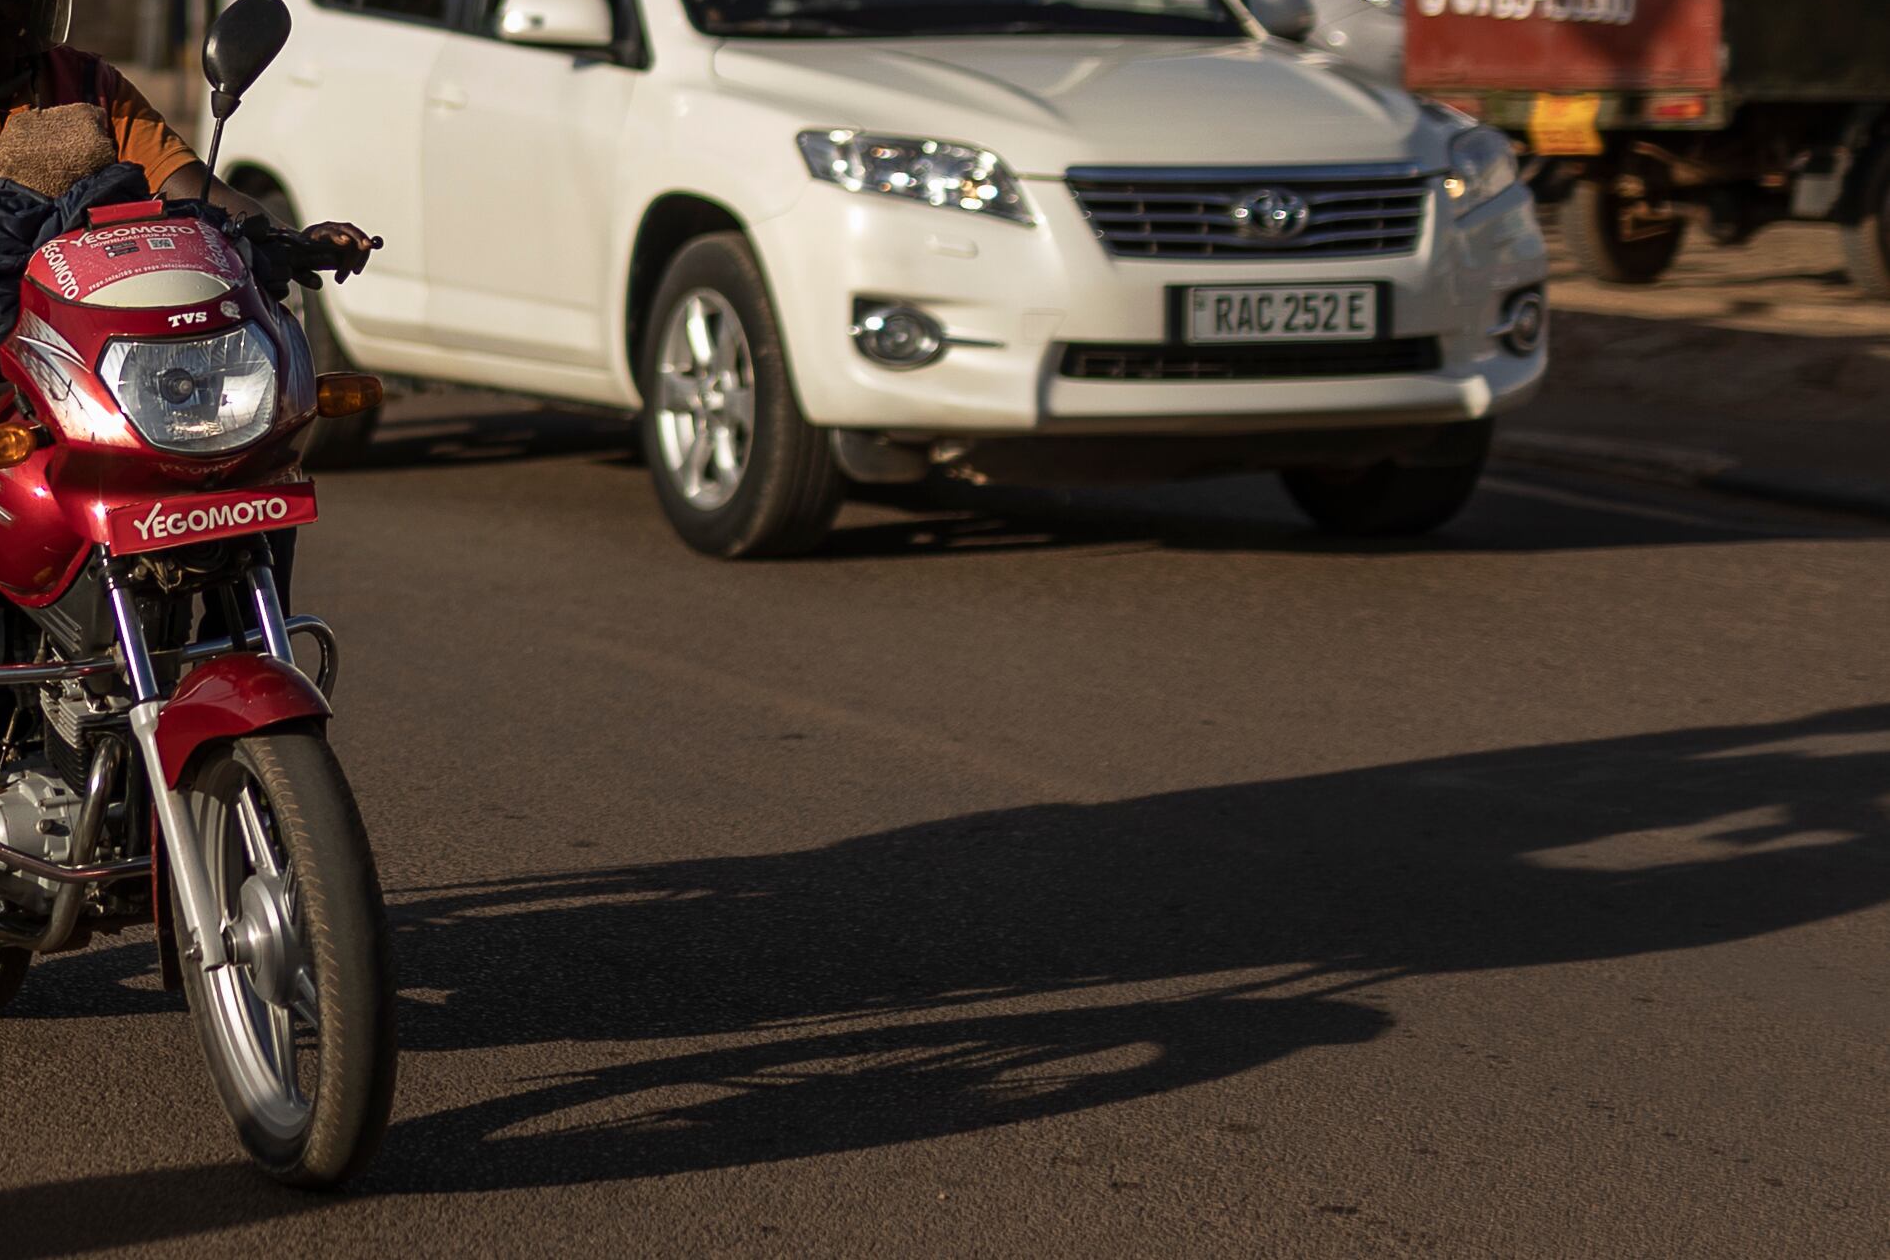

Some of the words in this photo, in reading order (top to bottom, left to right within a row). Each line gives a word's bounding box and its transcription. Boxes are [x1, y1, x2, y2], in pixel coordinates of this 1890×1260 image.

[70, 225, 196, 248] YEGOMOTO
[90, 234, 140, 249] DOWNLOAD
[40, 239, 80, 301] YEGOMOTO
[168, 311, 207, 328] TVS
[1214, 293, 1274, 334] RAC
[1282, 292, 1340, 333] 252
[1348, 291, 1365, 331] E
[133, 496, 288, 541] YEGOMOTO
